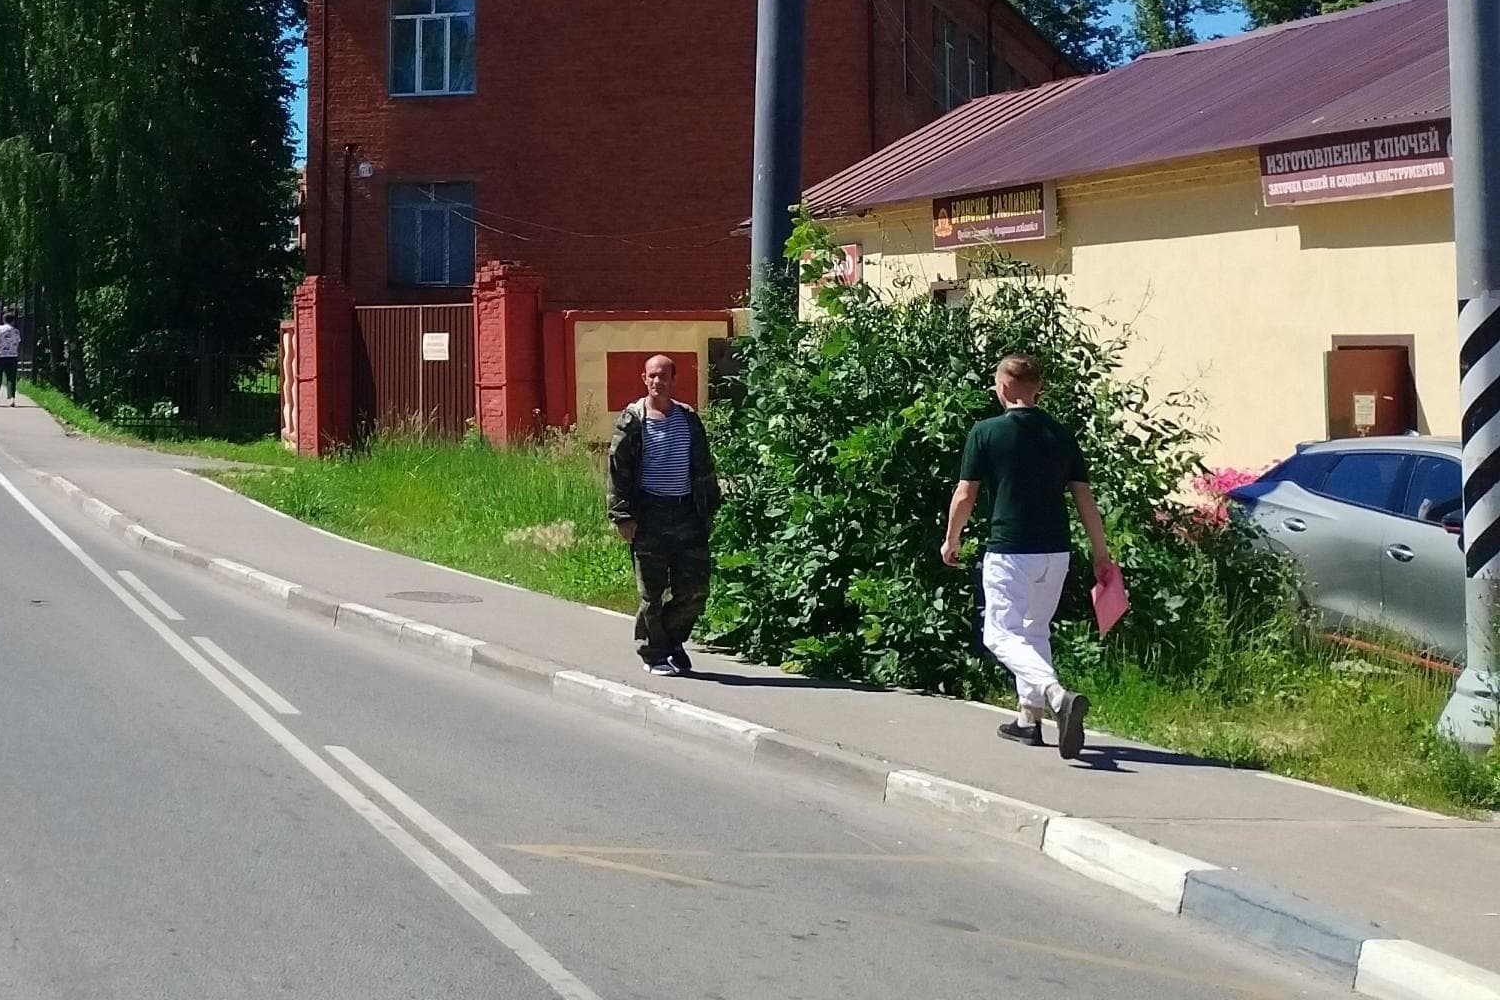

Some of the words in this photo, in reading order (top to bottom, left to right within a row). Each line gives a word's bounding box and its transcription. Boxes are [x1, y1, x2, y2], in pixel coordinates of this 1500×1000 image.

[1266, 142, 1371, 174] ИЗГОТОВЛЕНИЕ
[1373, 126, 1441, 160] КЛЮЧЕЙ
[1268, 179, 1303, 196] ЗАТОЧКА
[1302, 174, 1329, 192] ЦЕПЕЙ
[1329, 177, 1336, 189] И
[1337, 174, 1375, 189] САДОВЫХ
[1375, 161, 1446, 183] ИНСТРУМЕНТОВ
[992, 188, 1043, 219] РАЗЛИВНОЕ
